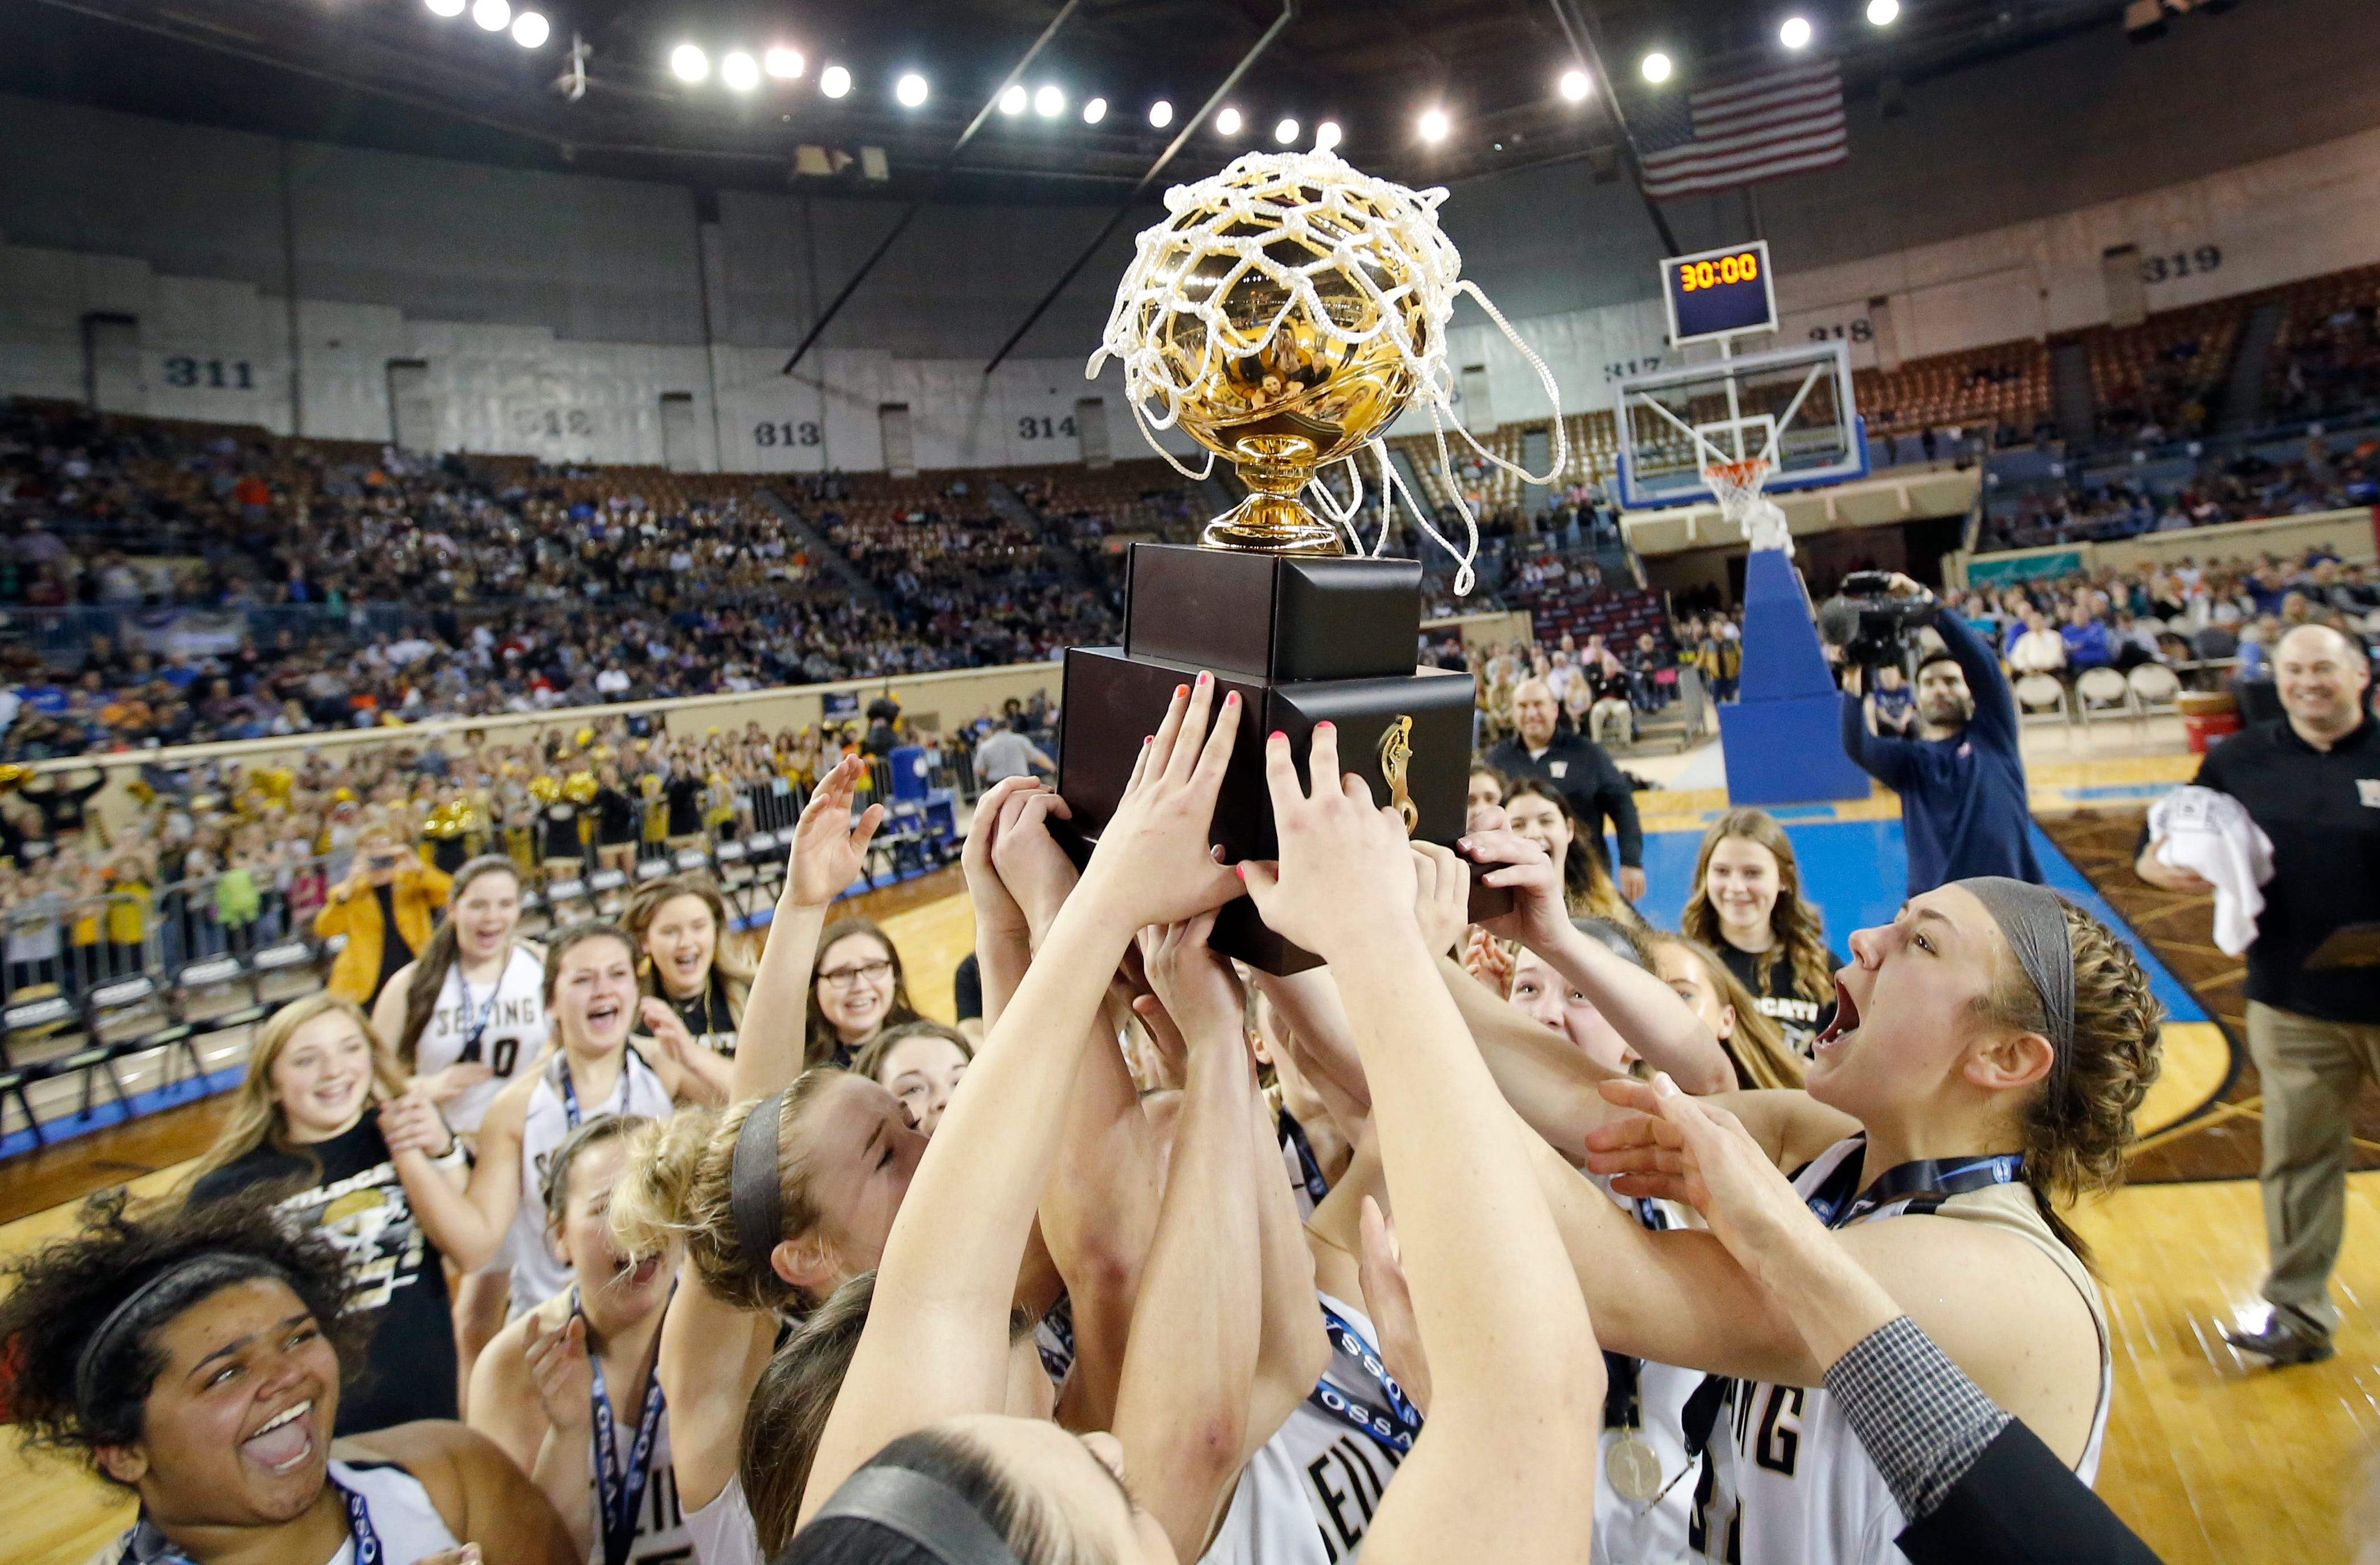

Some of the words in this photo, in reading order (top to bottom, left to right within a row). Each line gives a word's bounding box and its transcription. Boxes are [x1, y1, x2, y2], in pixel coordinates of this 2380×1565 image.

[1680, 252, 1758, 292] 30:00
[2140, 244, 2221, 283] 319
[164, 356, 254, 389] 311
[1018, 416, 1077, 440] 314
